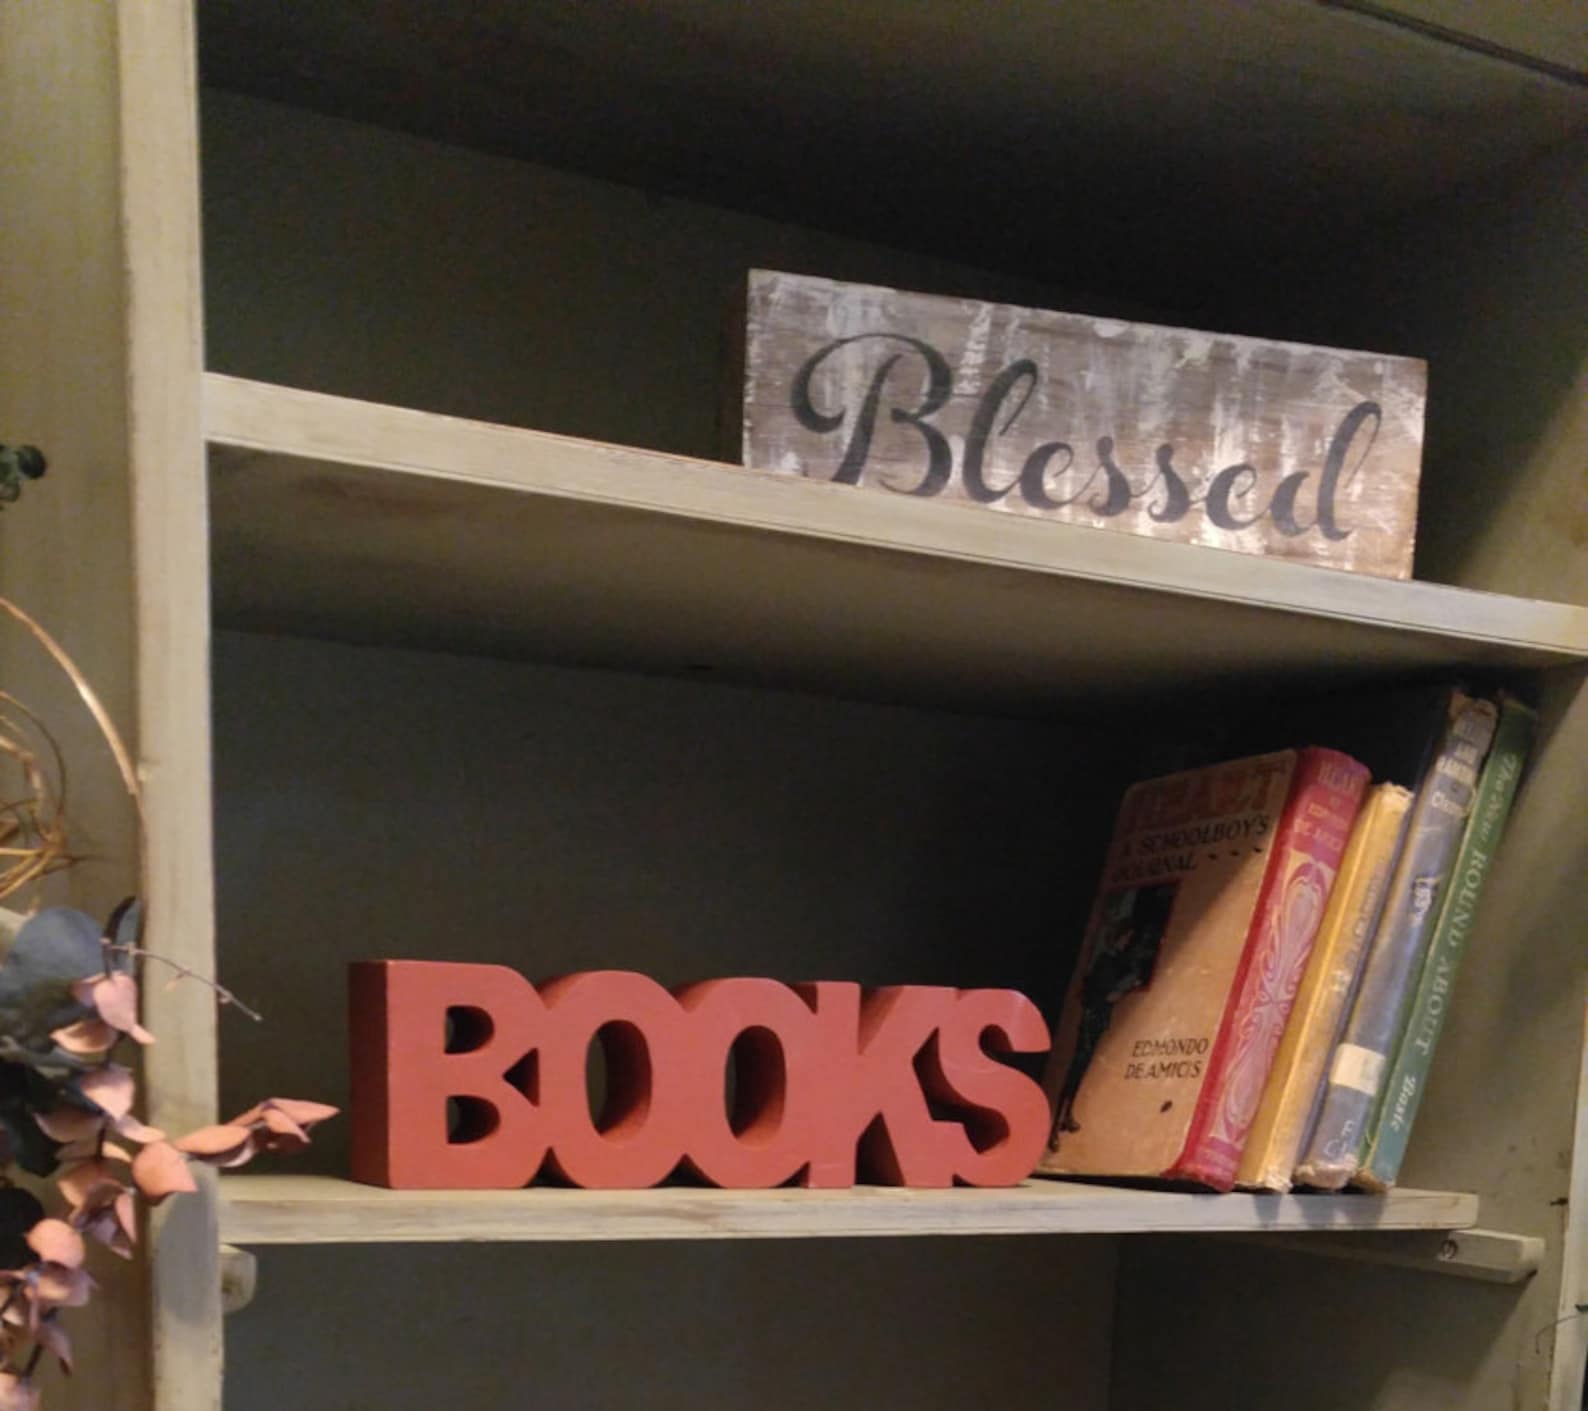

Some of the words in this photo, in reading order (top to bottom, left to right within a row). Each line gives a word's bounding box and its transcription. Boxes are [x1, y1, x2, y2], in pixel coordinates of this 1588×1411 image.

[790, 333, 1382, 542] Blessed
[1446, 850, 1488, 948] ROUND
[1132, 1038, 1209, 1058] EDMONDO
[1412, 956, 1452, 1057] ABOUT
[386, 960, 1051, 1189] BOOKS
